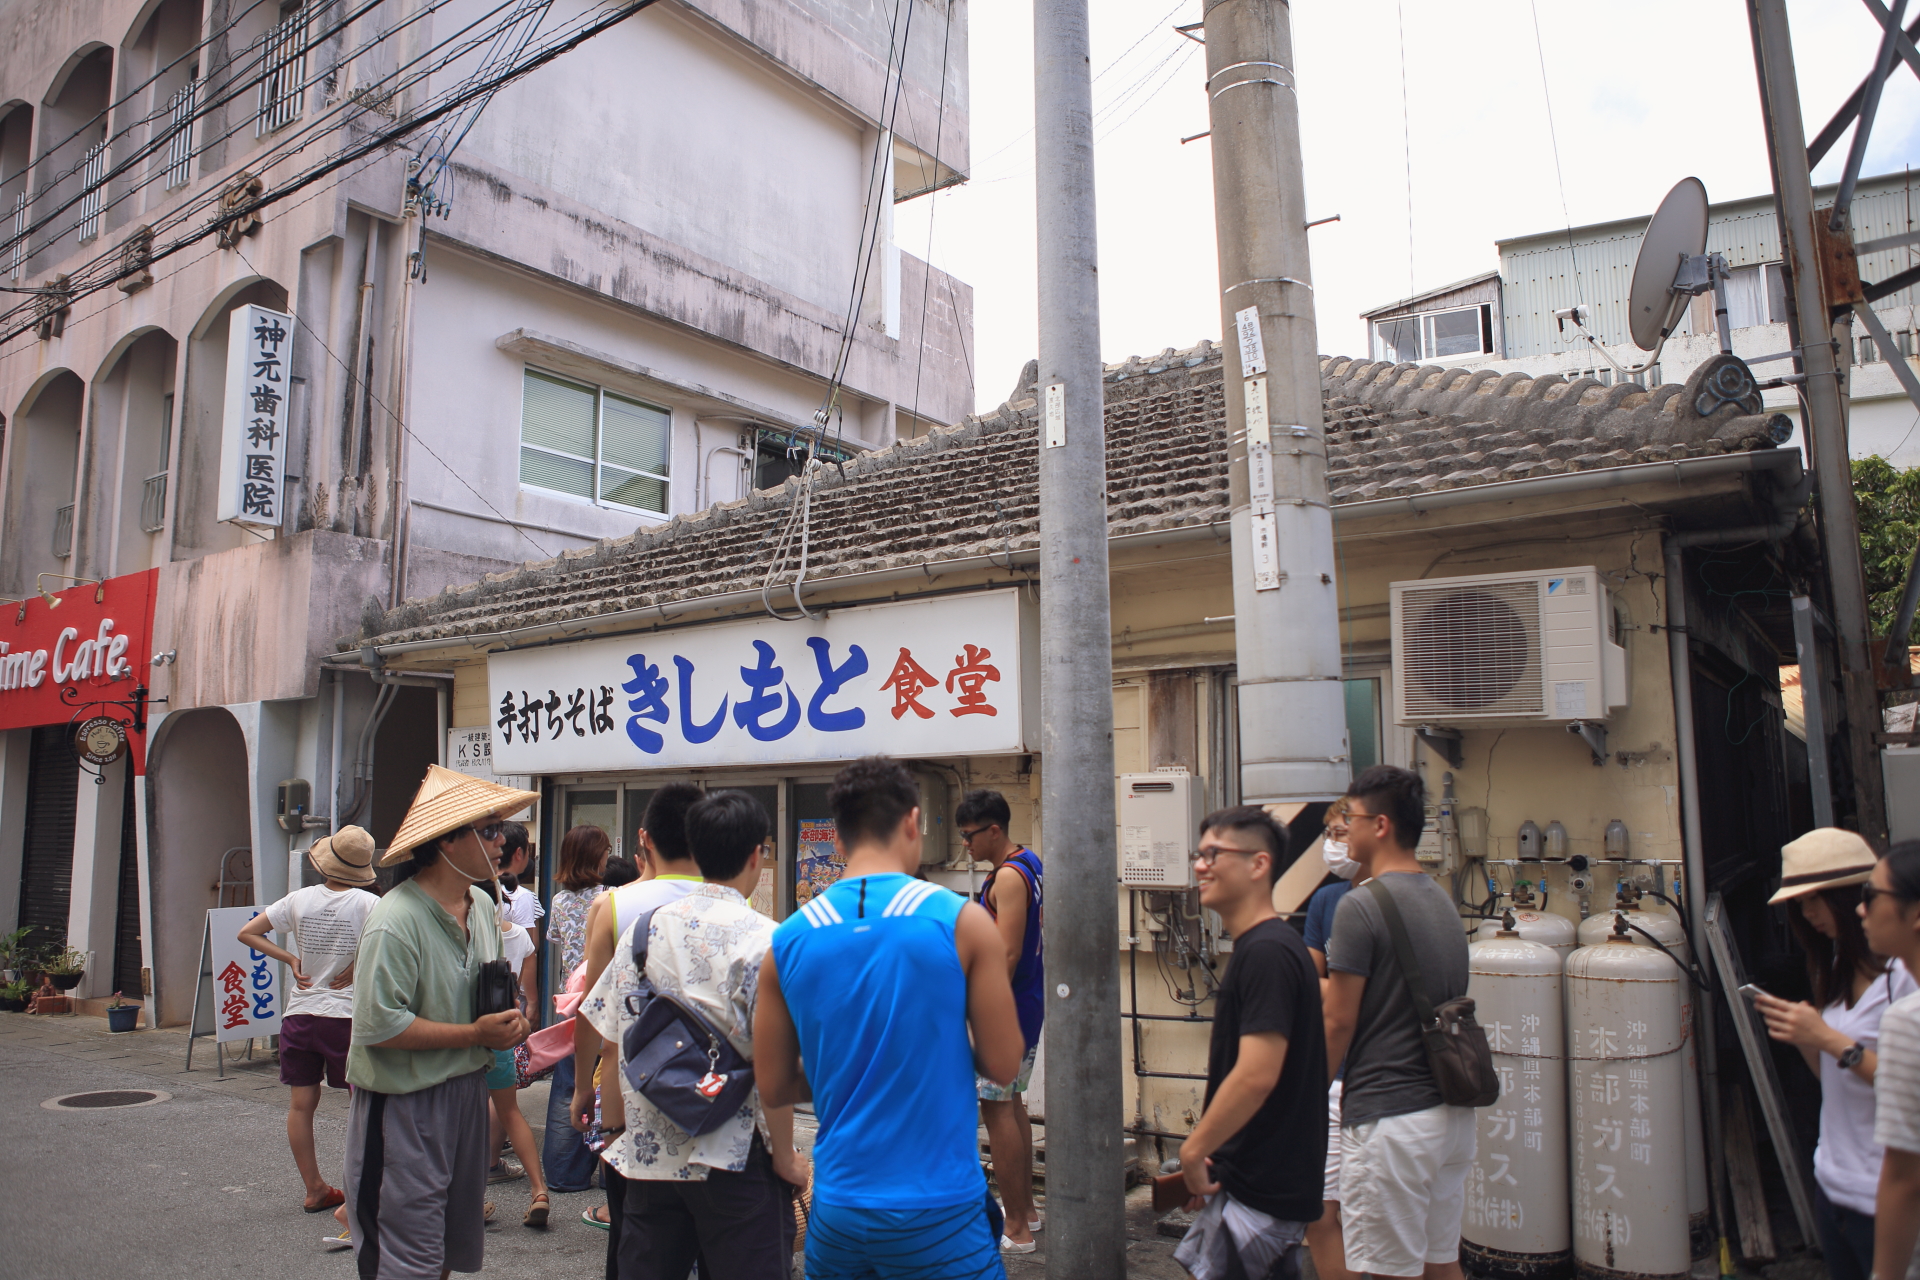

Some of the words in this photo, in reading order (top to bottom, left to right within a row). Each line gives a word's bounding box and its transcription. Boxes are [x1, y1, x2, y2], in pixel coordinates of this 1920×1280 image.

[242, 316, 287, 518] 神元歯科医院
[1262, 554, 1269, 564] 3
[0, 641, 48, 692] ime
[53, 618, 128, 684] Cafe
[80, 720, 108, 742] Espresso
[109, 720, 126, 742] Coffee
[497, 686, 614, 745] 手打ちそば
[622, 636, 869, 754] きしもと
[879, 644, 1001, 720] 食堂
[86, 752, 103, 762] Since
[217, 961, 250, 1030] 食堂
[1521, 1014, 1542, 1152] 沖縄県本部町
[1626, 1020, 1652, 1164] 沖縄県本部町
